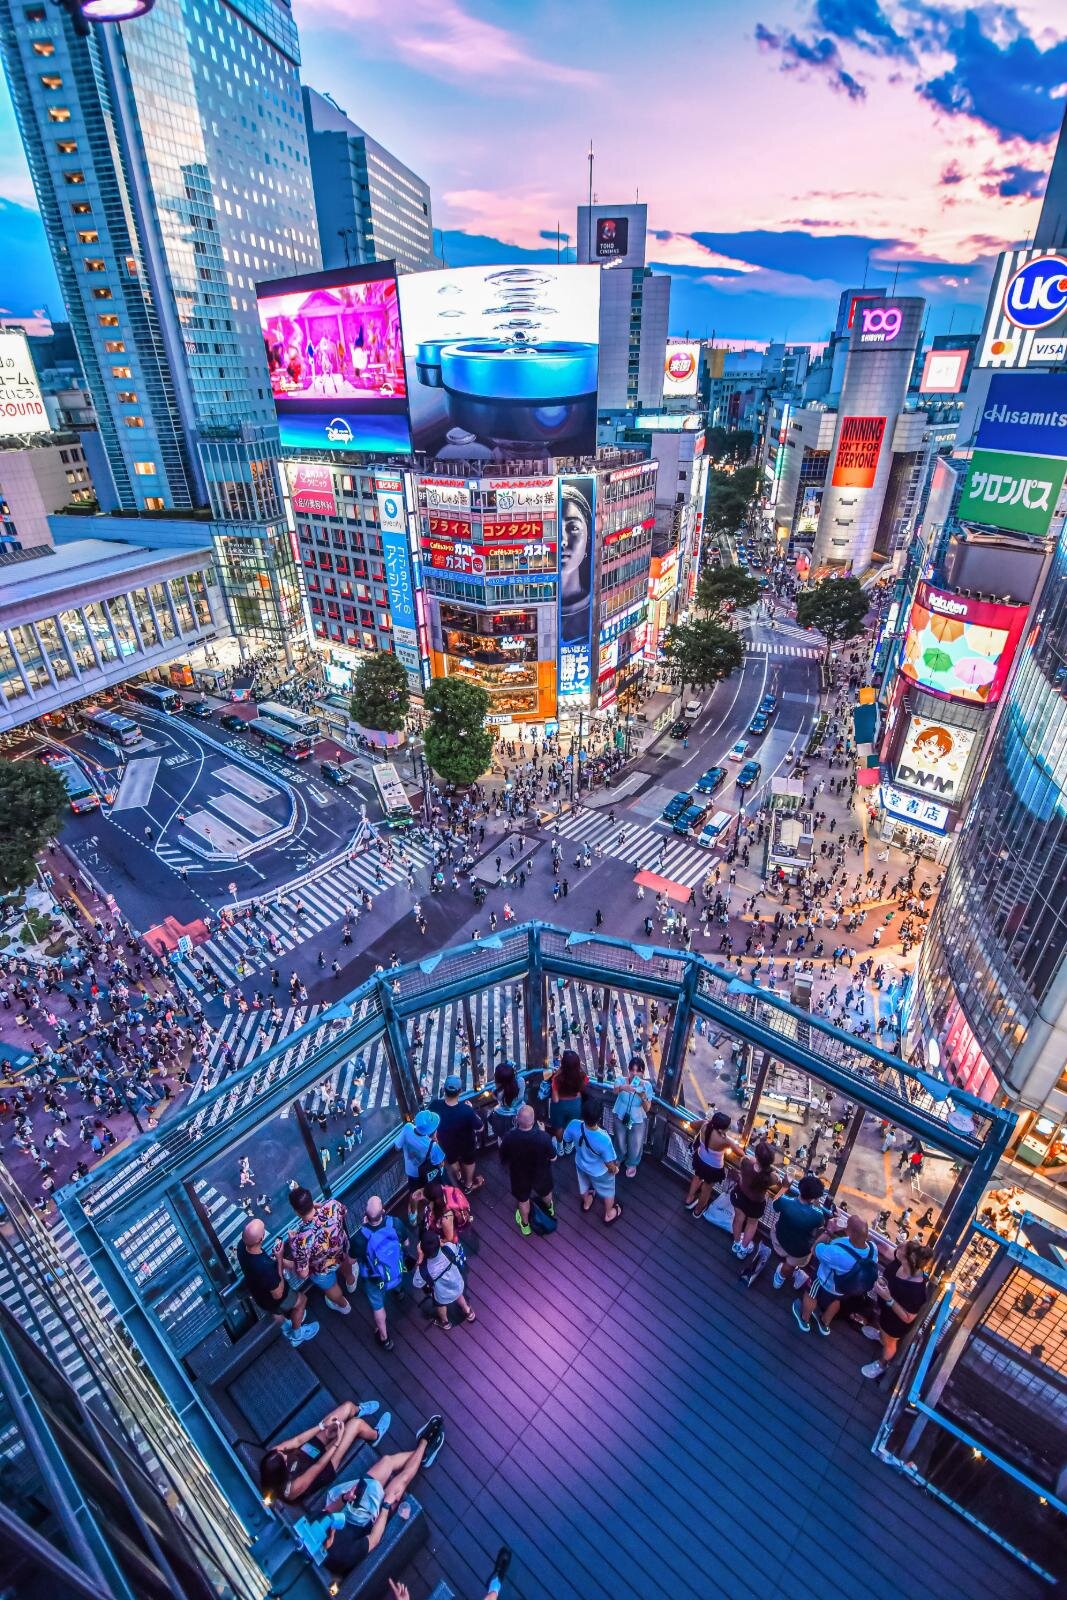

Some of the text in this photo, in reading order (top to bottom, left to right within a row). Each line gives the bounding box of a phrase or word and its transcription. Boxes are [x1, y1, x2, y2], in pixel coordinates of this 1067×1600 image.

[1012, 274, 1067, 310] UC
[862, 307, 902, 341] 109
[861, 333, 886, 342] SHIBUYA
[1036, 344, 1064, 355] VISA
[842, 418, 884, 442] WINNING
[840, 442, 880, 452] ISN'T FOR
[837, 451, 877, 469] EVERYONE.
[418, 491, 427, 500] 9F
[441, 489, 468, 505] しゃぶ葉
[517, 491, 555, 506] しゃぶ葉
[969, 471, 1053, 512] サロンパス
[430, 519, 471, 534] プライス
[484, 523, 541, 537] コンタクト
[423, 553, 432, 562] 7F
[454, 543, 476, 556] ガスト
[523, 544, 550, 557] ガスト
[445, 554, 470, 571] ガスト
[386, 544, 401, 613] アイシティ
[398, 546, 411, 615] コンタクトの
[929, 592, 968, 616] Rakuten
[897, 764, 954, 793] DMM
